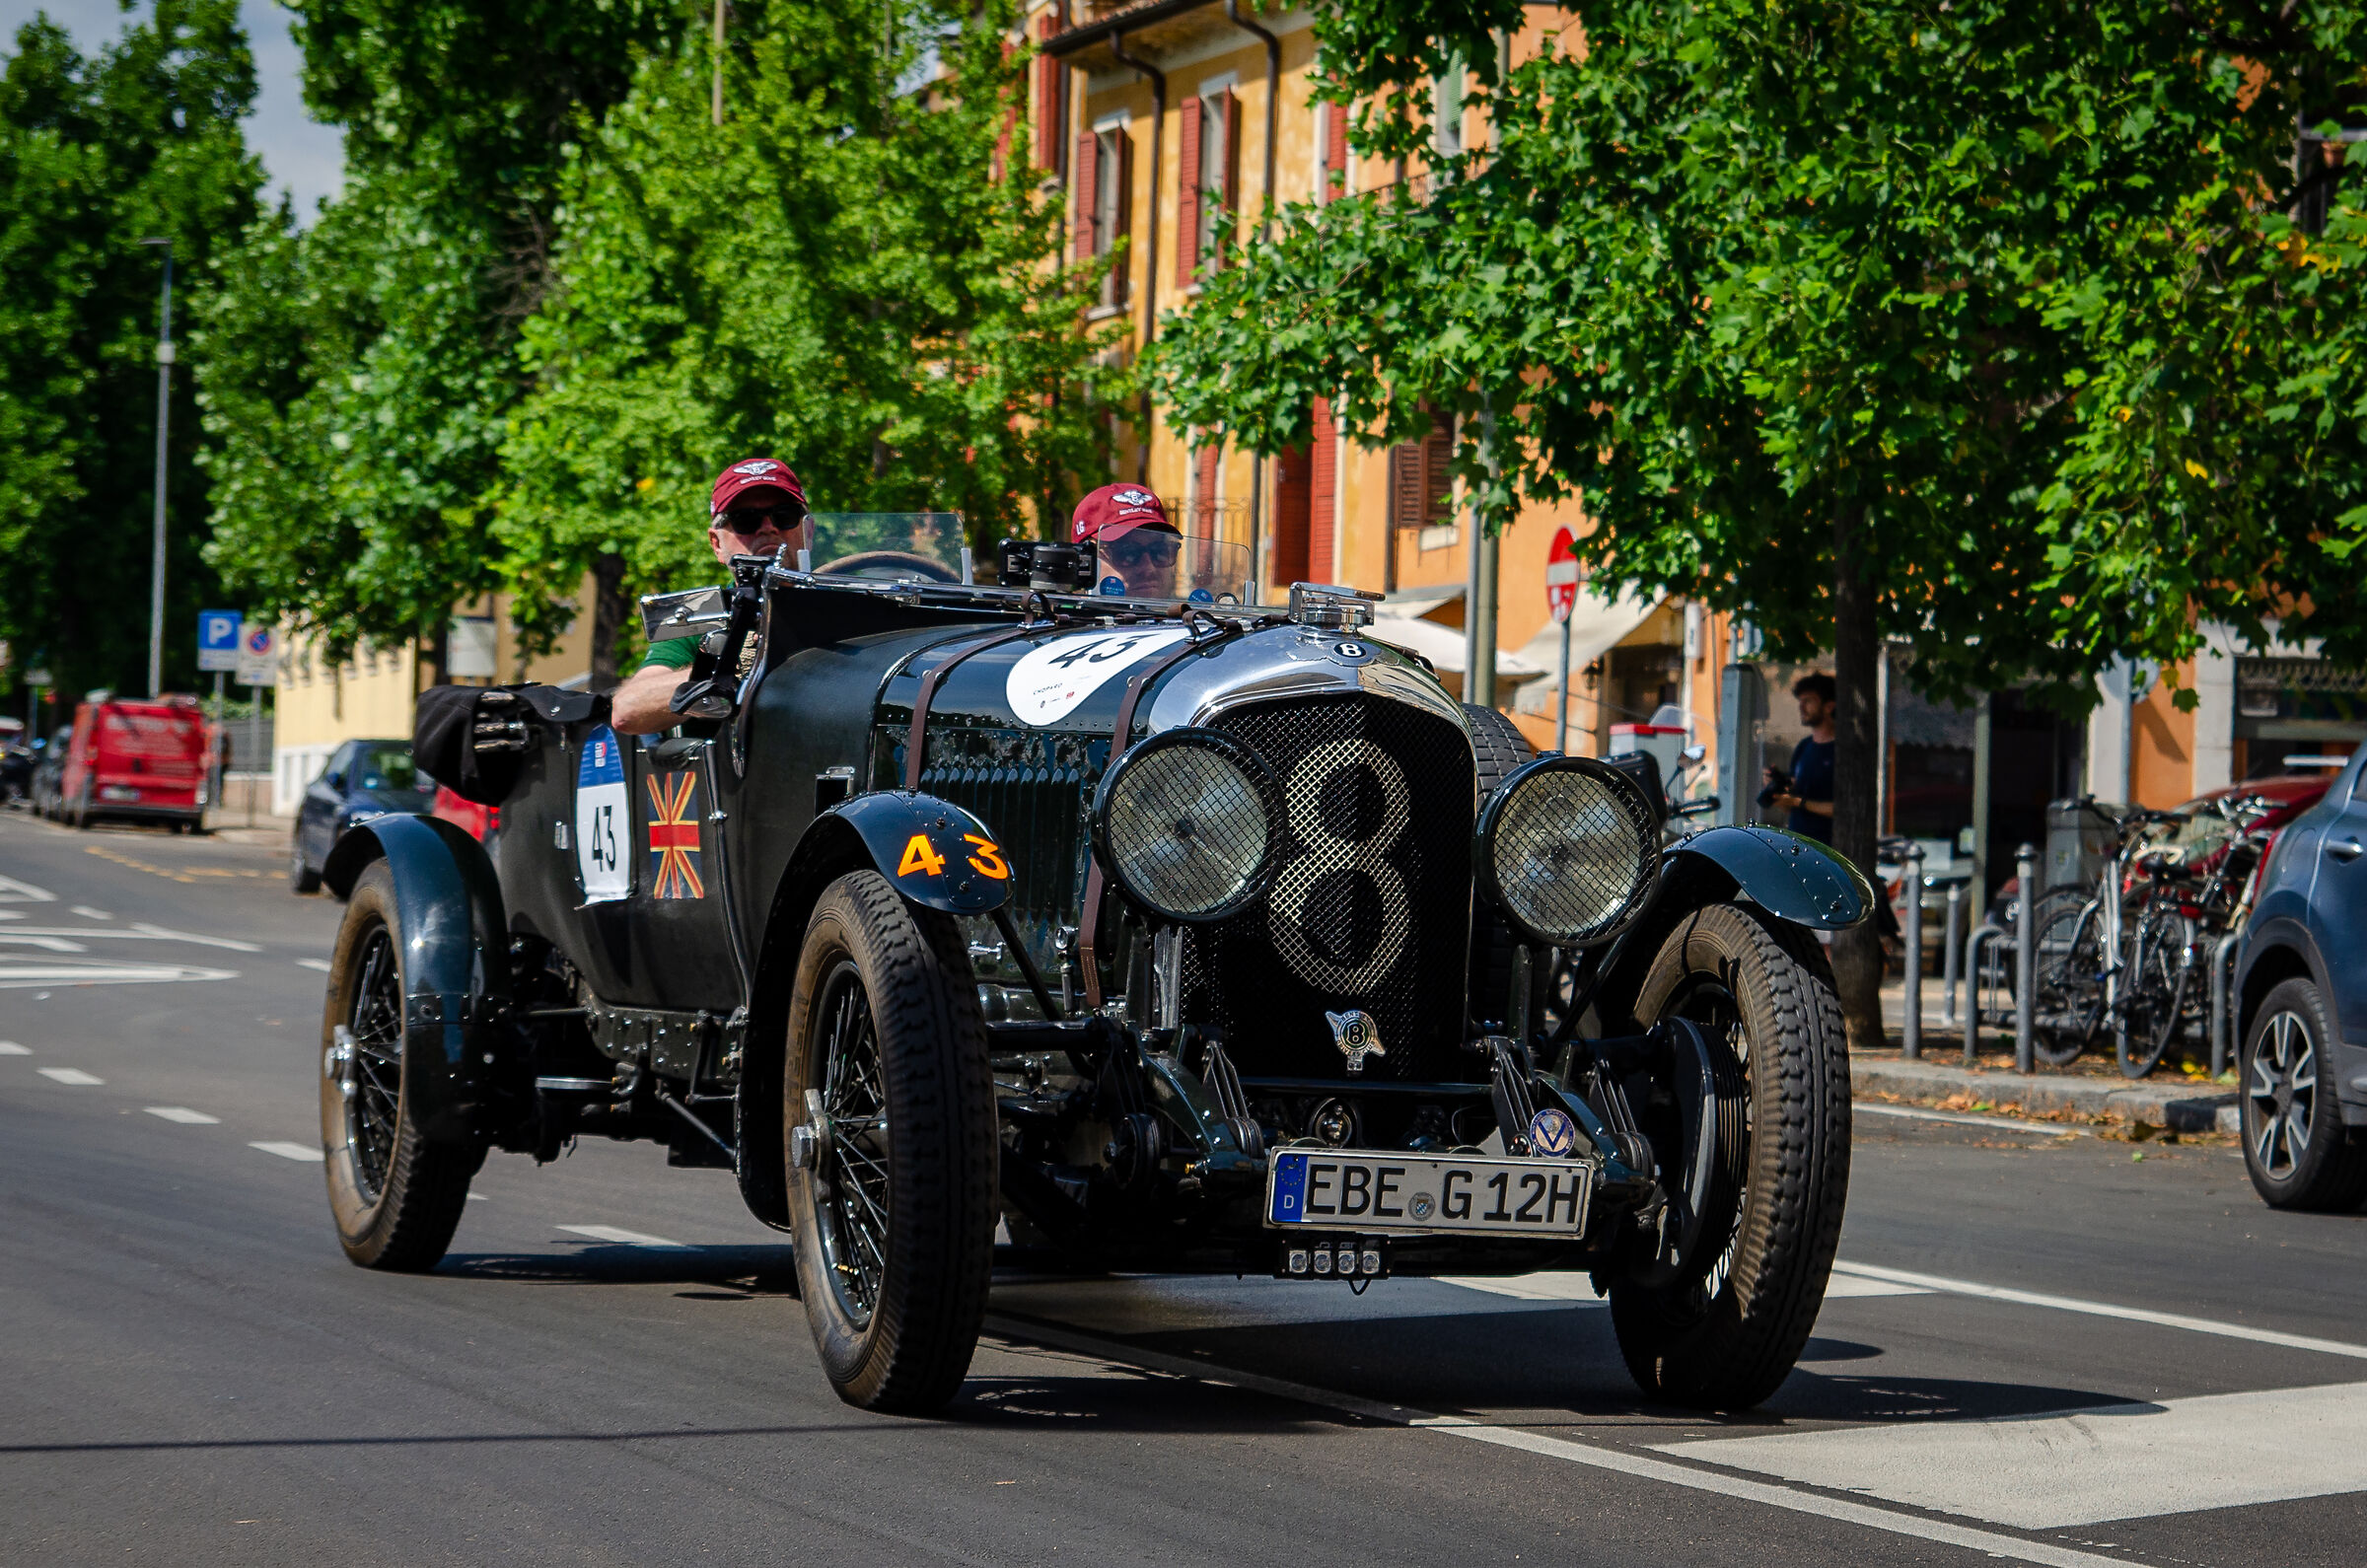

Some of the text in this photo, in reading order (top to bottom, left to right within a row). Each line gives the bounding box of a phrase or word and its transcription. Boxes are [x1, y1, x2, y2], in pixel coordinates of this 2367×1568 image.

[208, 617, 233, 645] P
[1047, 633, 1161, 670] 43
[1339, 643, 1362, 657] B
[592, 805, 616, 873] 43
[1267, 738, 1410, 996] 8
[1346, 1023, 1366, 1045] B
[1539, 1119, 1566, 1151] V
[1283, 1194, 1294, 1209] D
[1306, 1164, 1405, 1217] EBE
